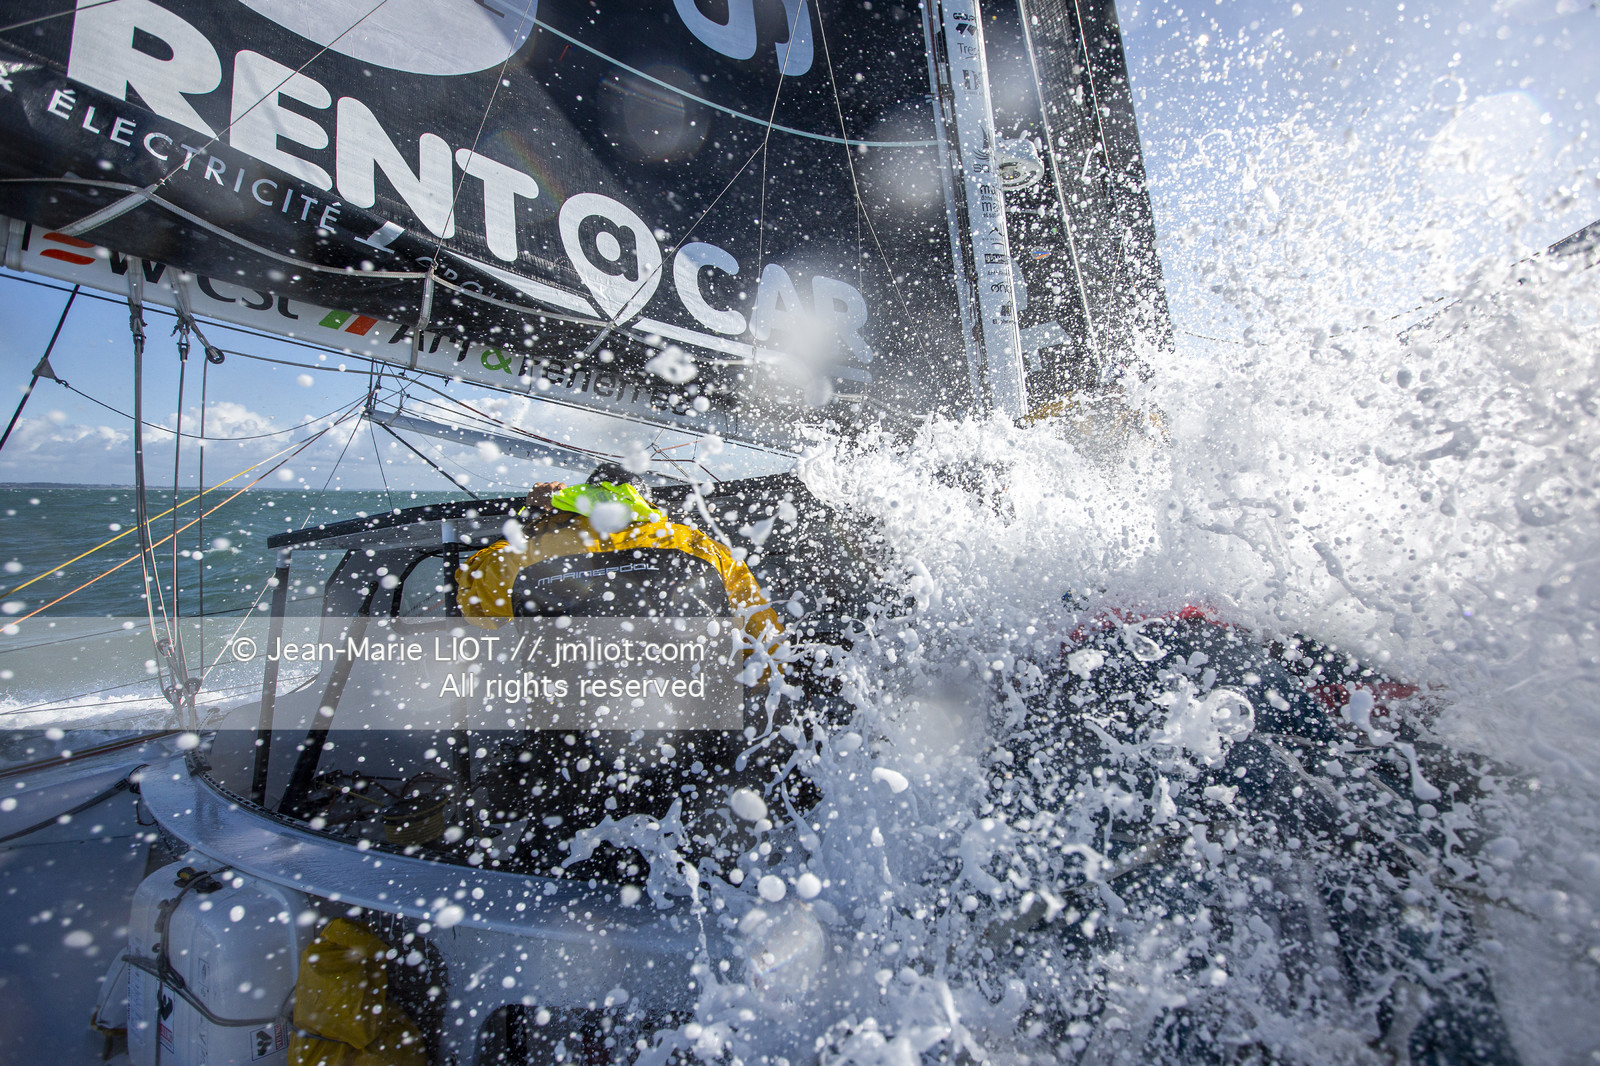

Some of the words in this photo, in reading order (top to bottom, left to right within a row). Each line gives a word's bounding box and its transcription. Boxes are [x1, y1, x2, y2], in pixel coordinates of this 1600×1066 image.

[47, 88, 342, 233] ÉLECTRICITÉ
[66, 0, 539, 263] RENT
[673, 242, 874, 364] CAR
[537, 562, 660, 587] MARINEPOOL
